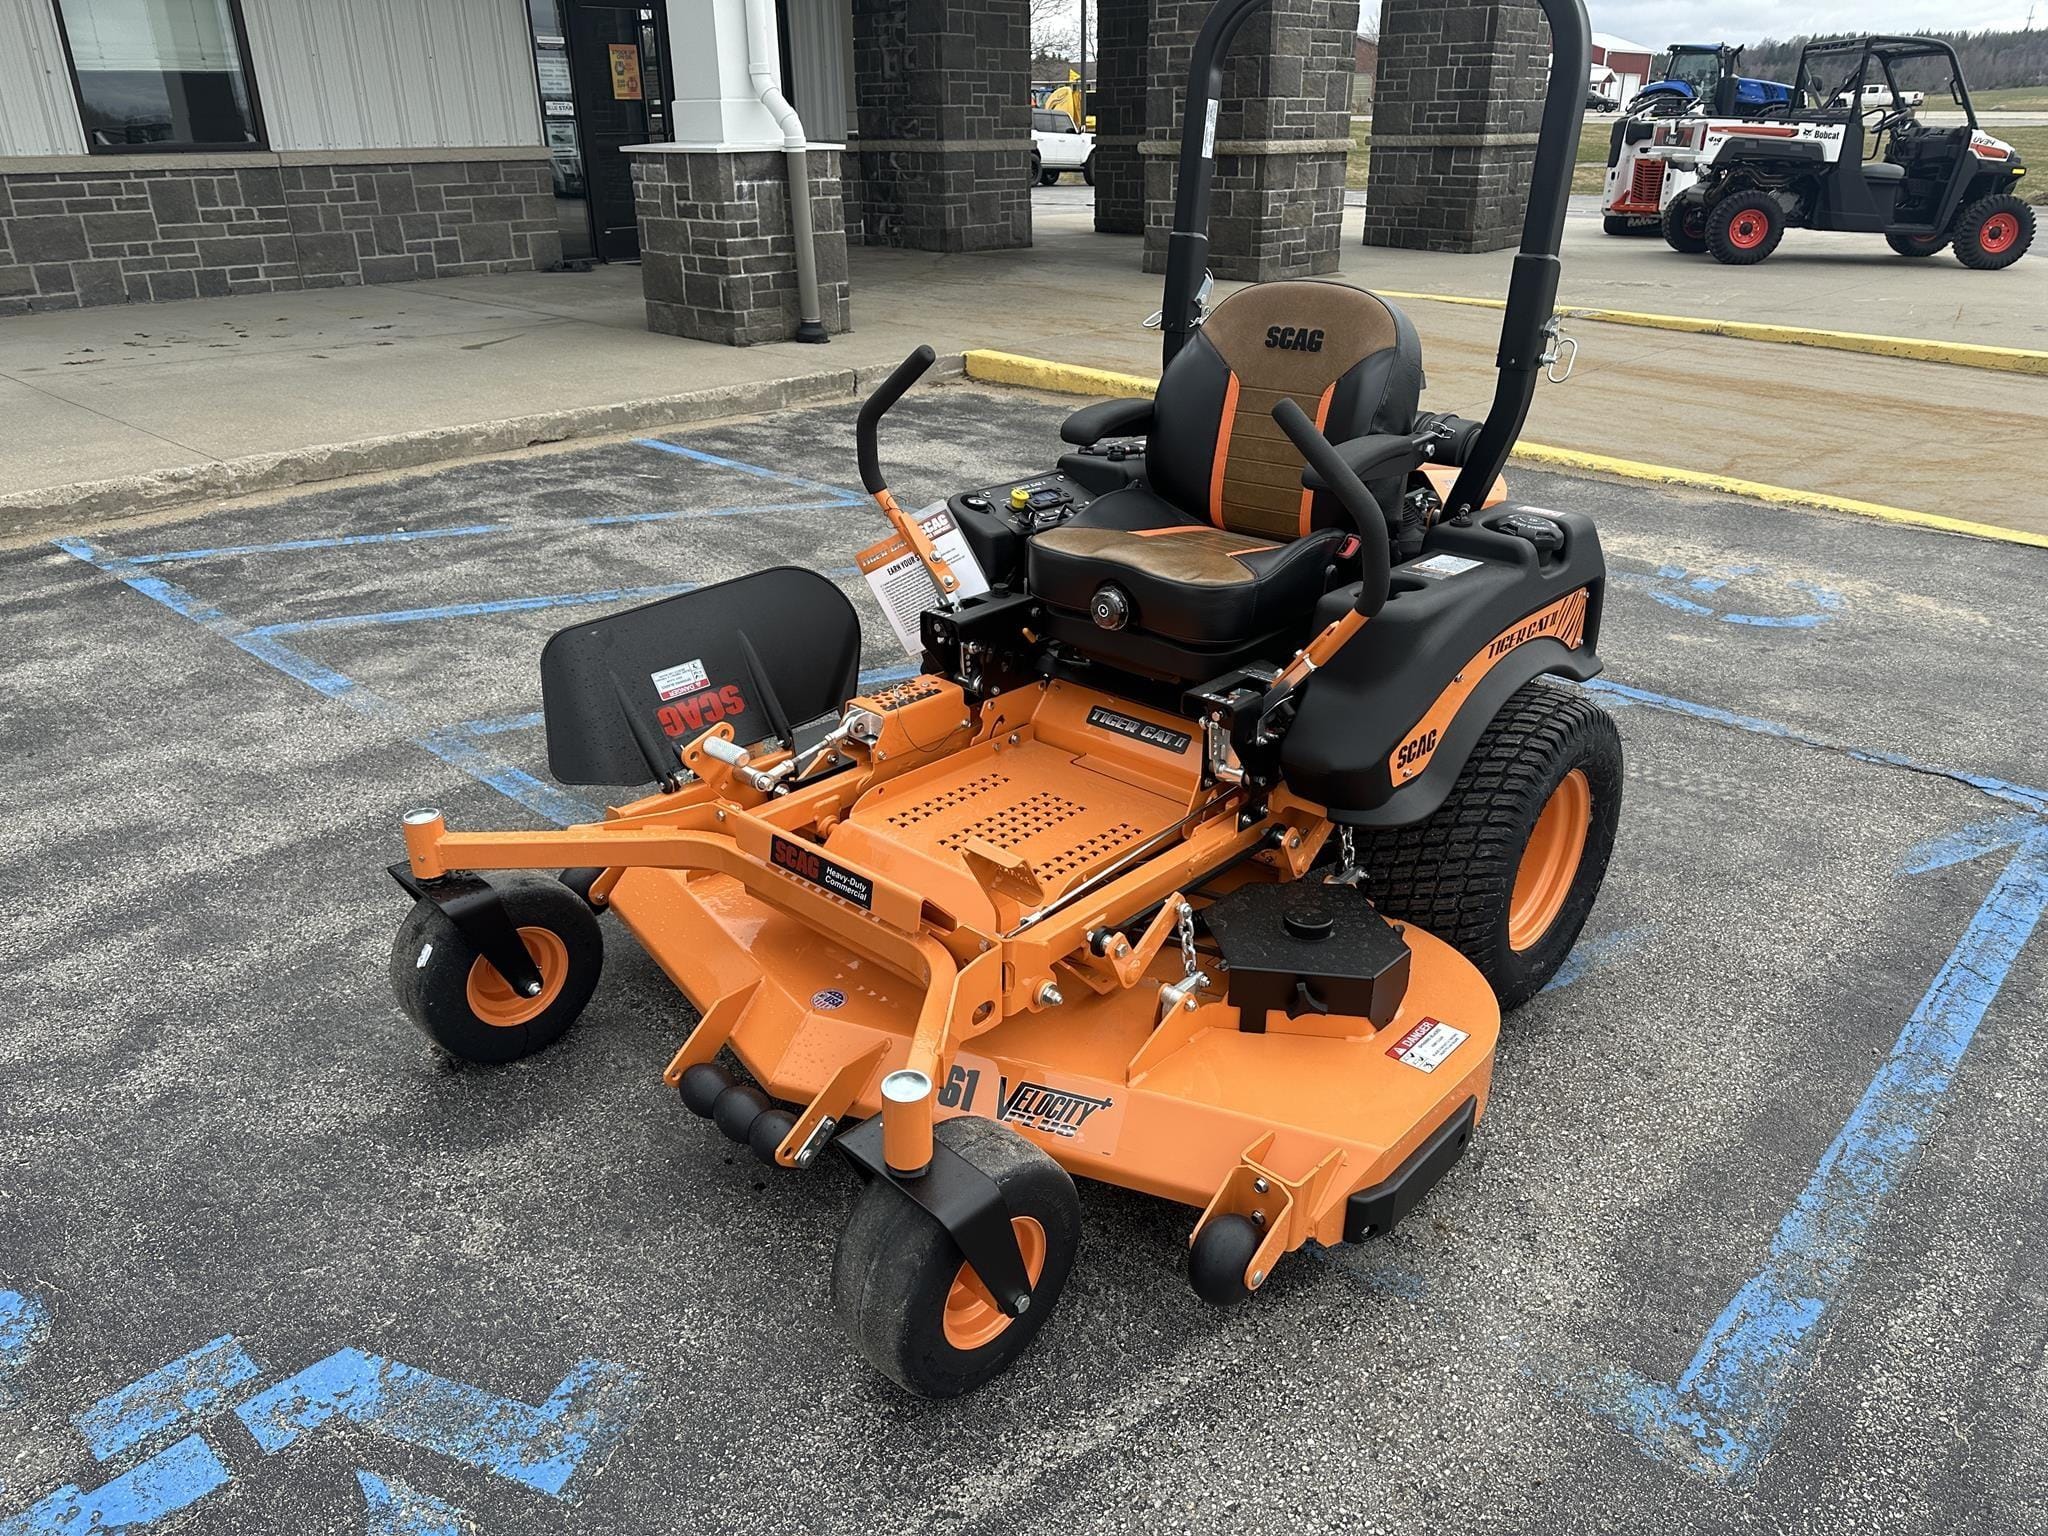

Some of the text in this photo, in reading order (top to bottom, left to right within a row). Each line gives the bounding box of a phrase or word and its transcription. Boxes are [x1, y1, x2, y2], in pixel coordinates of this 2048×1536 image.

[1814, 130, 1840, 140] Bobcat
[1973, 136, 1996, 146] UV34
[1265, 326, 1325, 352] SCAG
[887, 563, 902, 576] EARN
[901, 557, 917, 571] YOUR
[1487, 629, 1525, 660] TIGER
[1527, 616, 1550, 640] CAT
[658, 686, 744, 736] SCAG
[1091, 708, 1140, 734] TIGER
[1397, 729, 1438, 769] SCAG
[775, 840, 867, 892] SCAG Heavy-Duty
[825, 875, 868, 901] Commercial
[824, 995, 843, 1008] USA
[1402, 1021, 1435, 1048] DANGER
[937, 1065, 981, 1112] 61
[1004, 1111, 1078, 1138] PLUS
